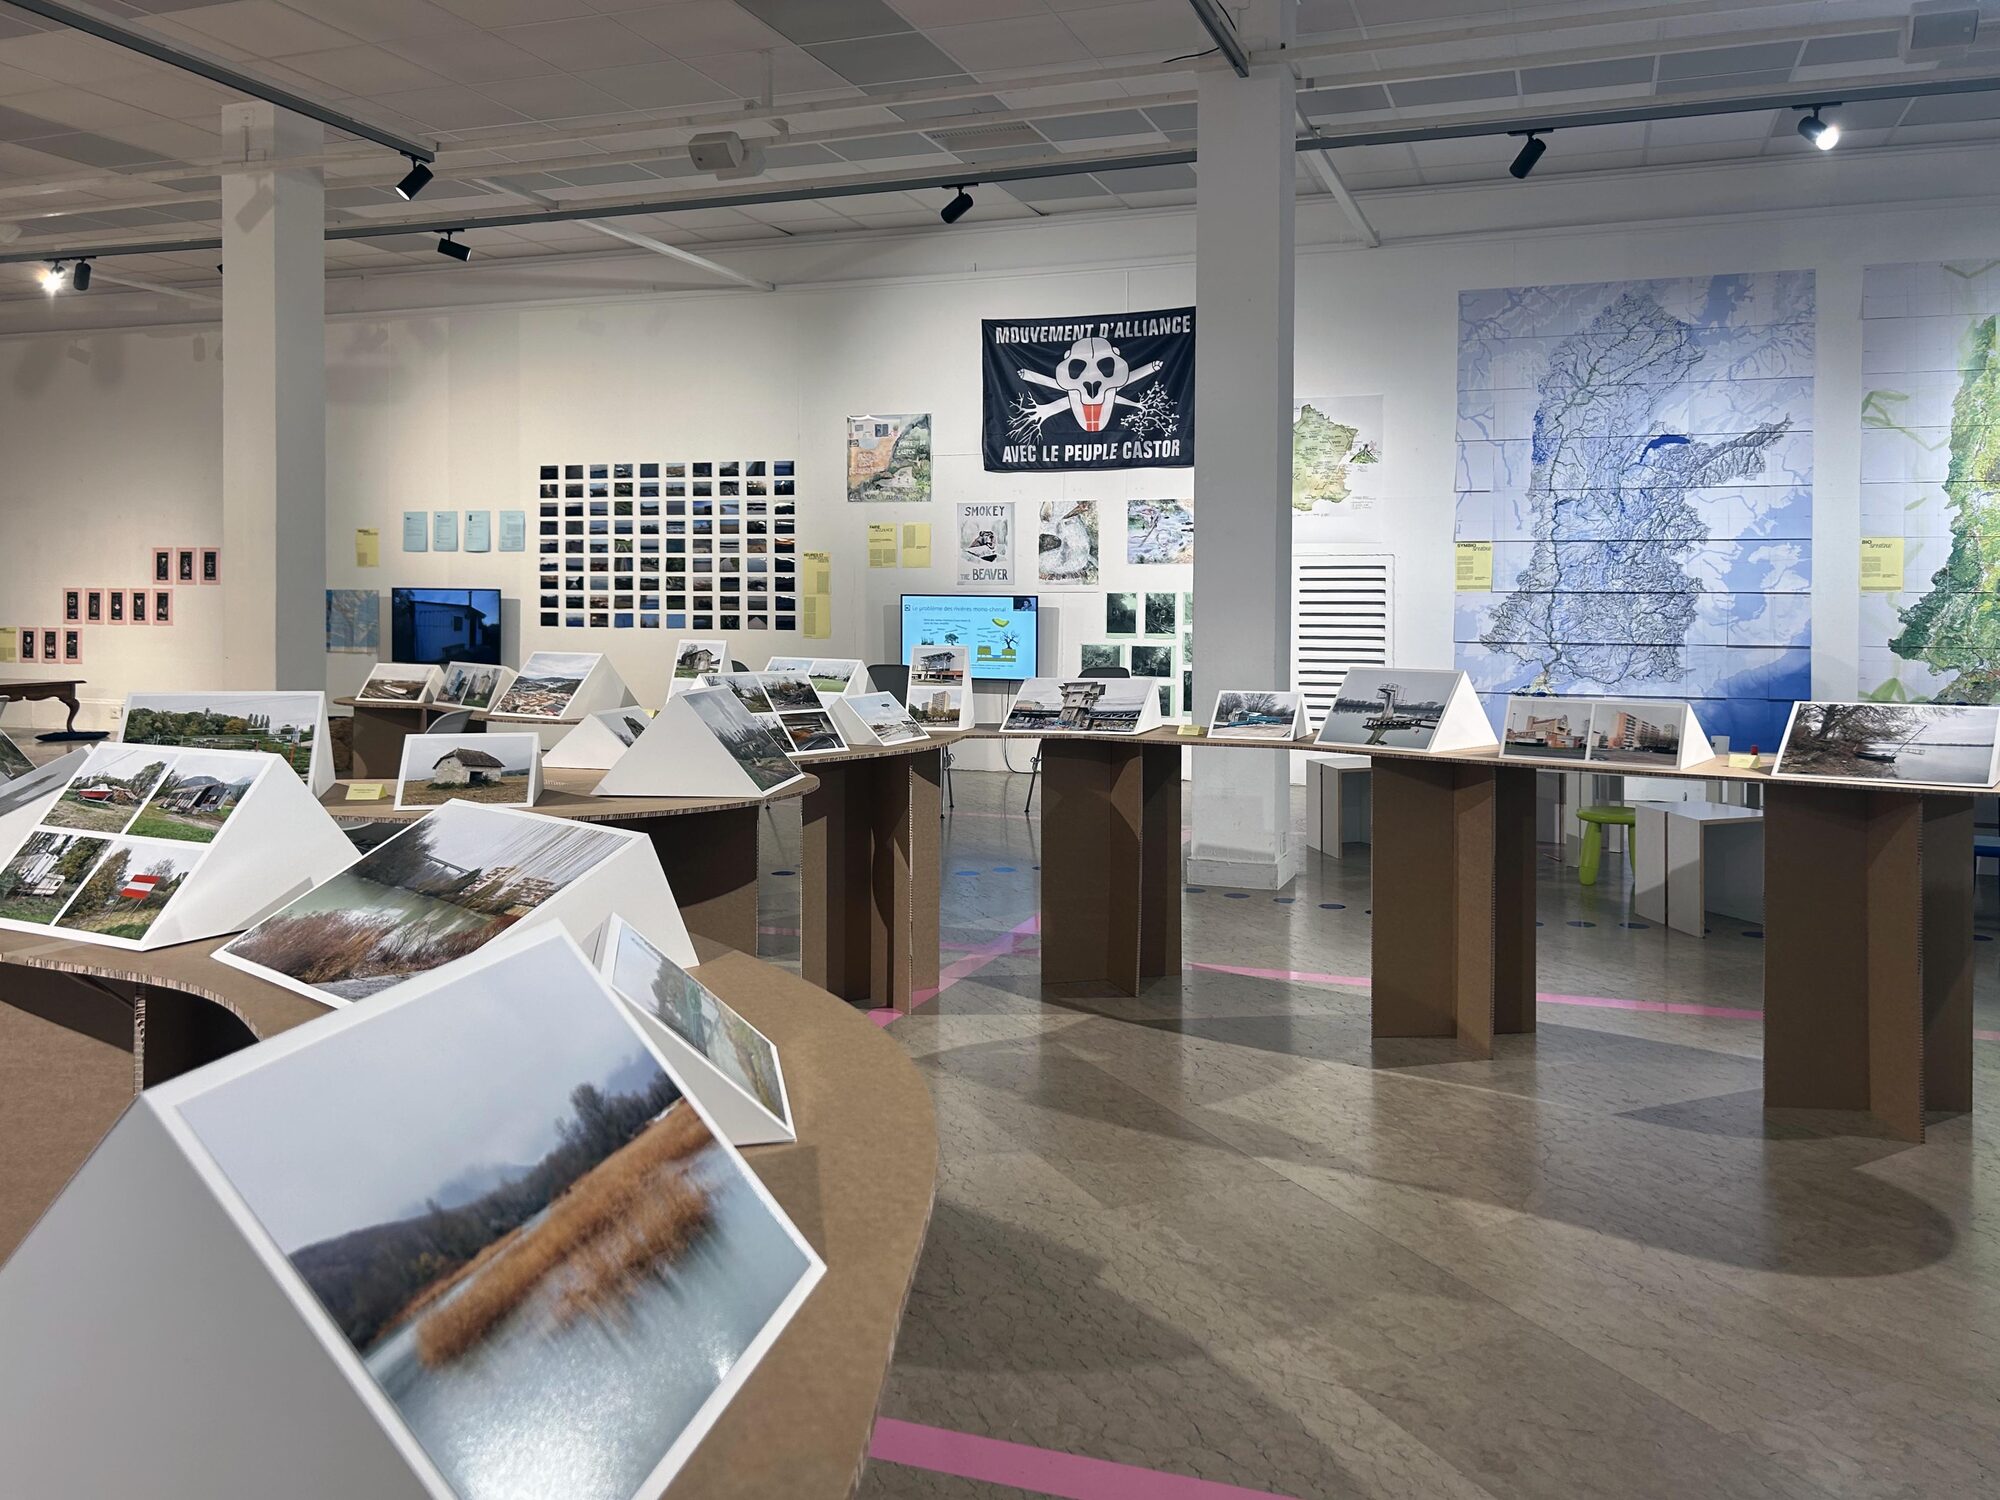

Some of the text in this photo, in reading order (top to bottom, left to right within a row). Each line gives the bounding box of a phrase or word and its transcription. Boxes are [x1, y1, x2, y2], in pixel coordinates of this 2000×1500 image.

[996, 315, 1191, 344] MOUVEMENT D'ALLIANCE
[1002, 439, 1180, 463] AVEC LE PEUPLE CASTOR
[964, 505, 1005, 517] SMOKEY
[972, 568, 1008, 581] BEAVER
